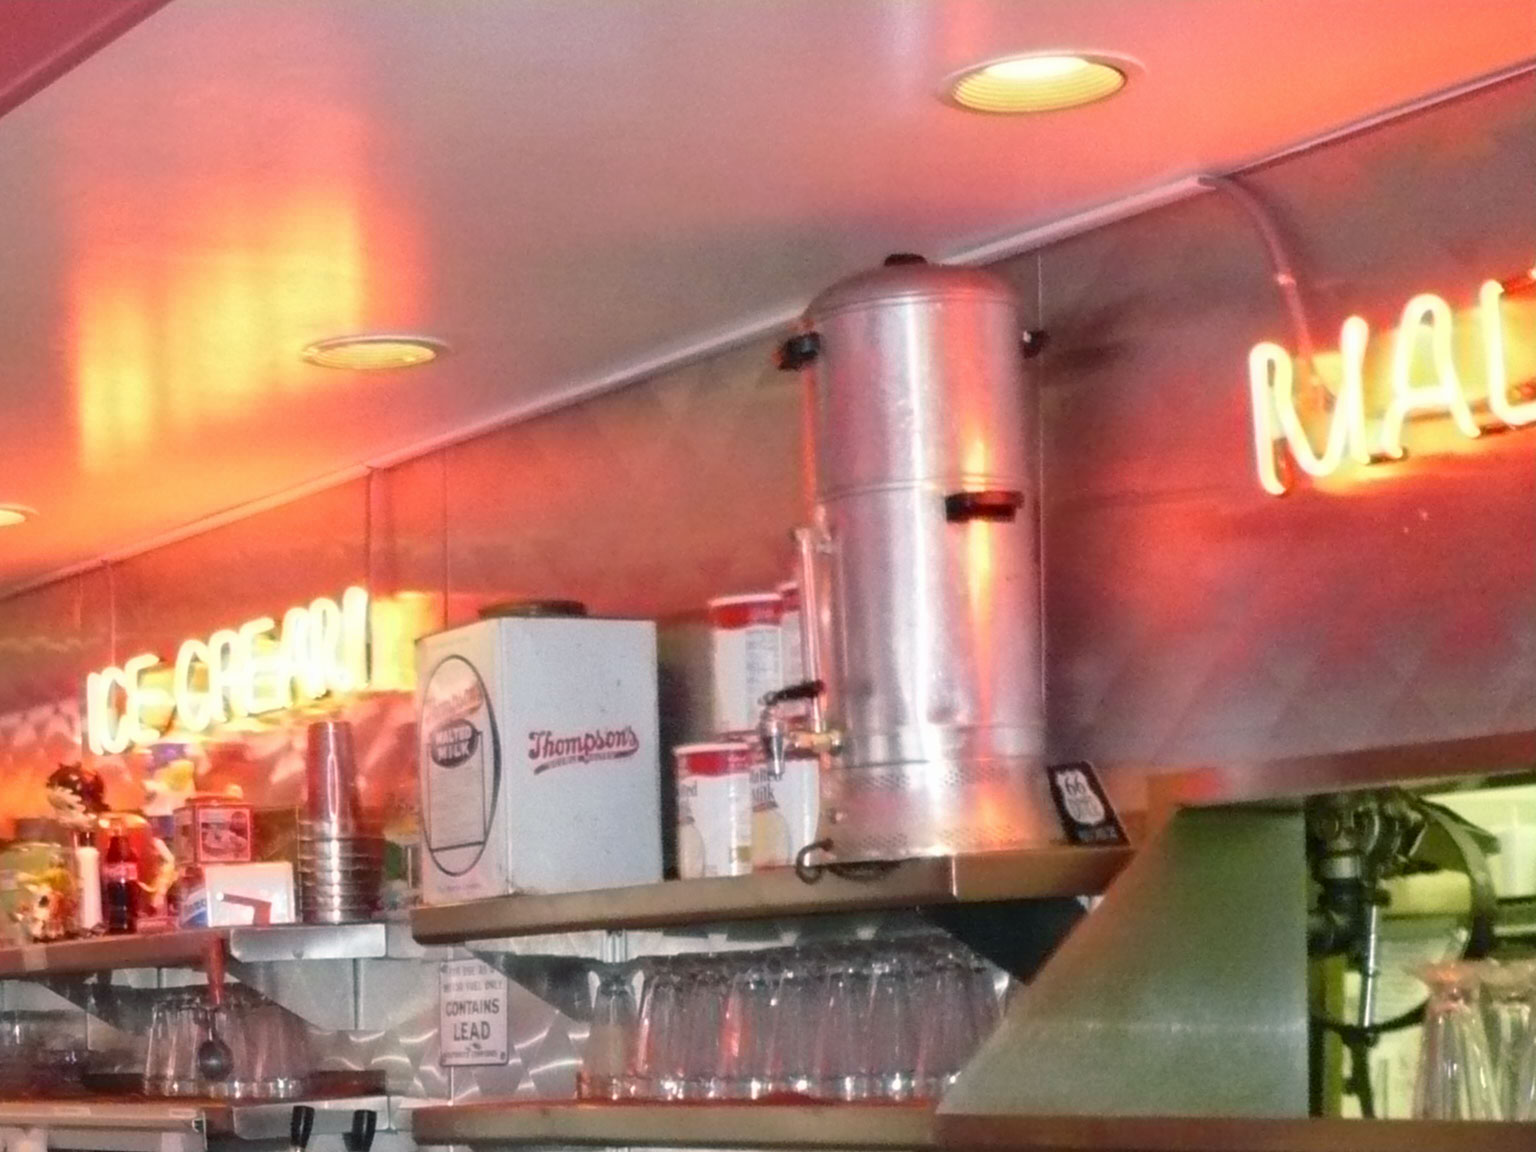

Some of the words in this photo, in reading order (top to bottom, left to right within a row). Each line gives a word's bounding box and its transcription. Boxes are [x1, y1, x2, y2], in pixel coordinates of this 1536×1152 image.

[87, 653, 161, 755] ICE
[174, 586, 369, 732] CREAM
[528, 725, 639, 760] Thompson's
[445, 998, 501, 1017] CONTAINS
[453, 1020, 491, 1042] LEAD
